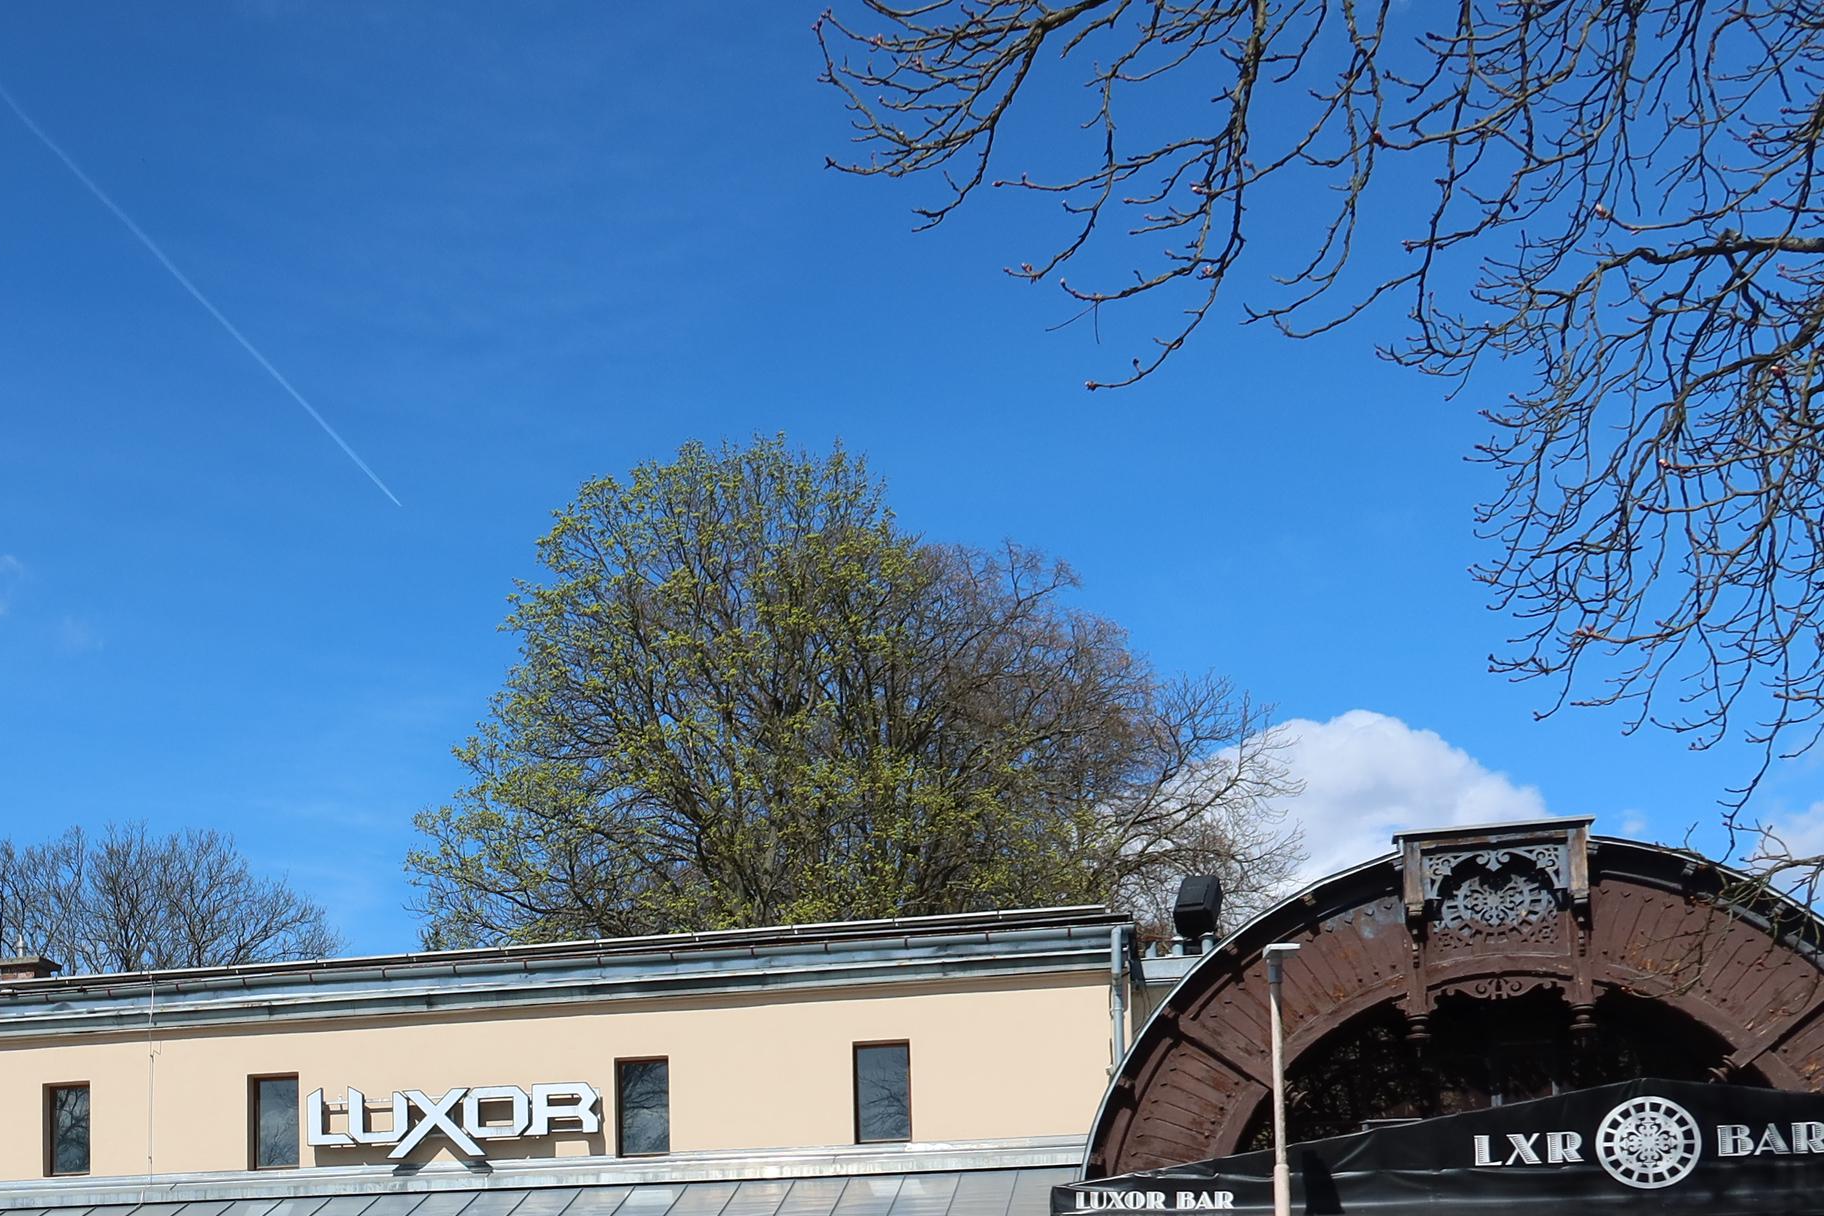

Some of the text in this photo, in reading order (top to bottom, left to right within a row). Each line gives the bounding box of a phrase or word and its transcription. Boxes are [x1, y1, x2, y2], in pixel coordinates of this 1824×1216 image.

[306, 1081, 600, 1160] LUXOR
[1474, 1120, 1824, 1167] LXR BAR
[1075, 1190, 1235, 1210] LUXOR BAR
